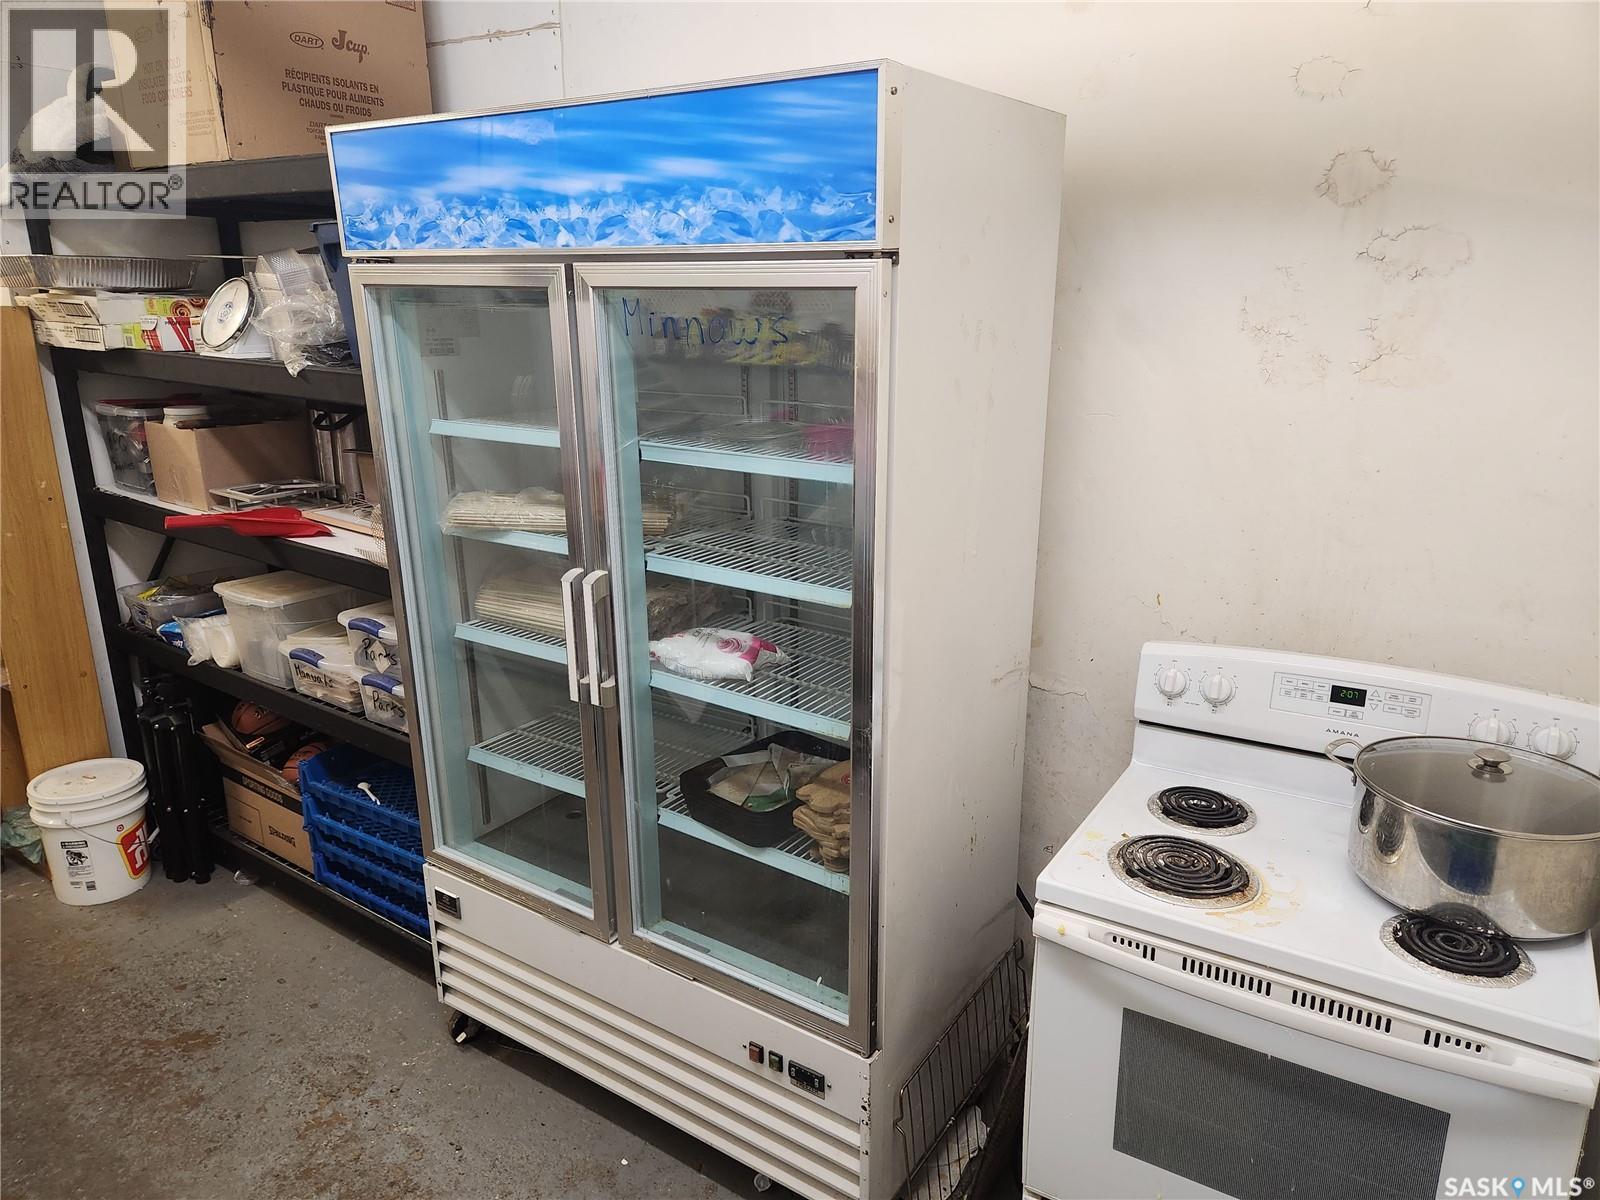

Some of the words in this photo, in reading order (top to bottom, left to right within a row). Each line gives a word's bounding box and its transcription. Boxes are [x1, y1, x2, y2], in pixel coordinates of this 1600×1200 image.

[294, 34, 320, 46] DART
[285, 68, 331, 86] RÉCIPIENTS
[333, 77, 368, 92] ISOLANTS
[369, 84, 379, 94] EN
[281, 81, 325, 98] PLASTIQUE
[326, 88, 347, 101] POUR
[349, 92, 384, 107] ALIMENTS
[299, 97, 331, 111] CHAUDS
[333, 102, 344, 113] OU
[345, 105, 372, 118] FROIDS
[621, 297, 790, 347] Minnows
[293, 662, 335, 689] Manuals
[1339, 689, 1359, 700] 2:07
[1325, 727, 1360, 738] AMANA
[268, 824, 297, 849] SPALDING
